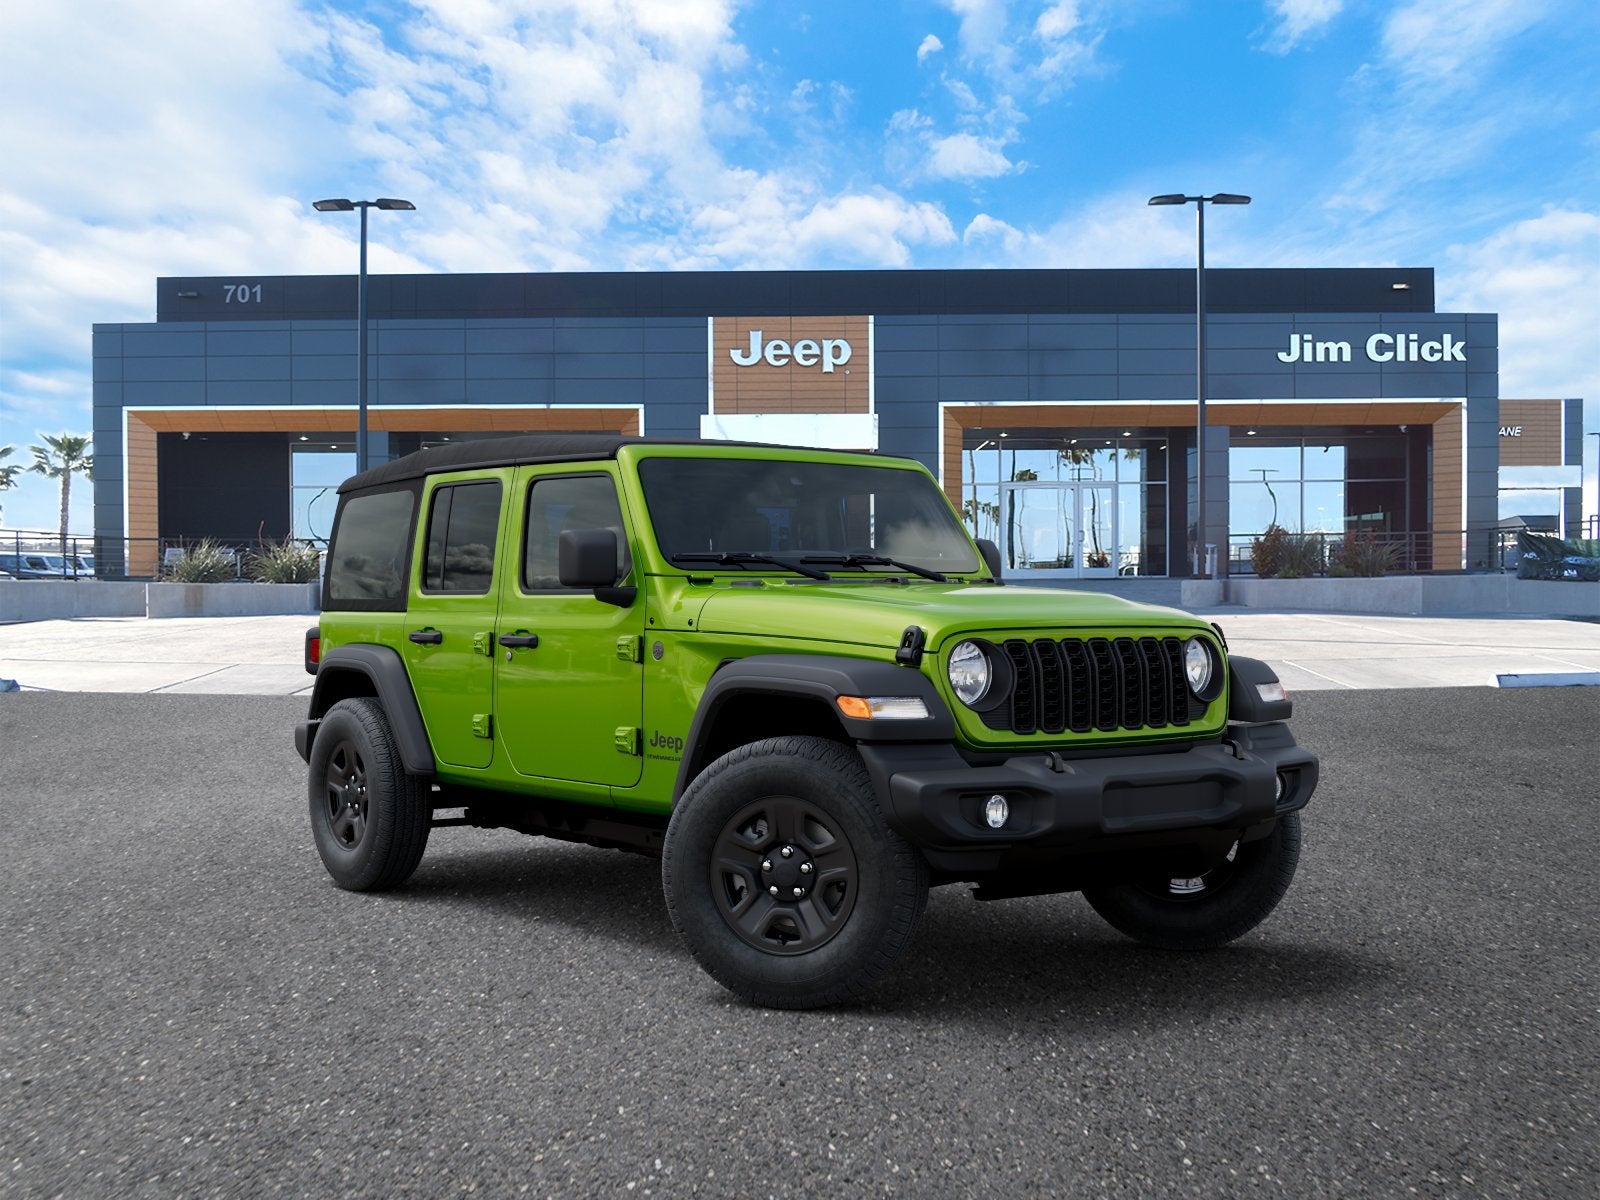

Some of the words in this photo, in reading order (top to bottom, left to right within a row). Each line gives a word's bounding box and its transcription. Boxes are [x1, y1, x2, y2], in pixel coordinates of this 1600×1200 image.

[223, 284, 262, 303] 701
[729, 330, 852, 373] Jeep
[1277, 333, 1351, 363] Jim
[1366, 333, 1467, 363] Click
[649, 730, 684, 753] Jeep
